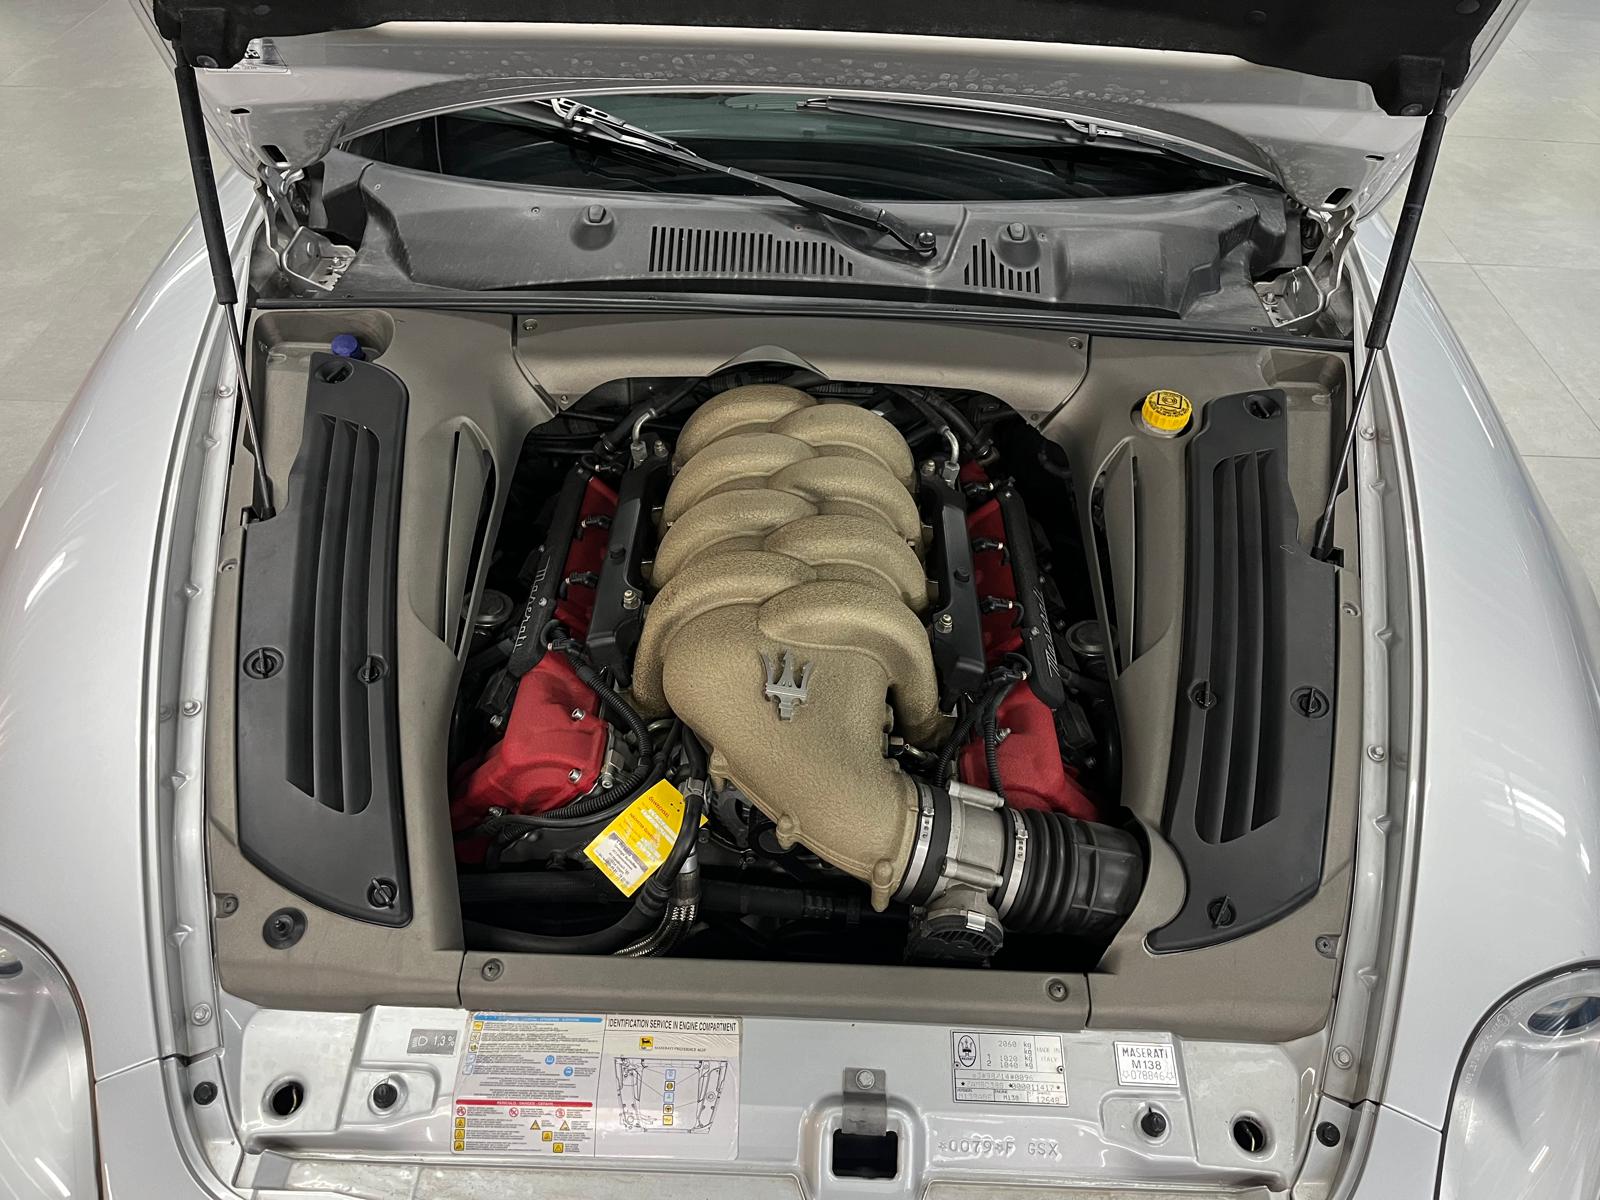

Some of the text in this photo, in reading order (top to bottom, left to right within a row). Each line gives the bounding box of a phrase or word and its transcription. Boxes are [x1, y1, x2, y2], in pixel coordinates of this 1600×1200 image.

[513, 556, 550, 653] Maserati
[608, 1018, 649, 1028] IDENTIFICATION
[650, 1020, 672, 1030] SERVICE
[673, 1021, 679, 1030] IN
[680, 1021, 698, 1031] ENGINE
[699, 1022, 737, 1032] COMPARTMENT
[999, 1040, 1032, 1049] 2060 kg
[1122, 1047, 1168, 1059] MASERATI
[1131, 1059, 1162, 1071] M138
[1027, 1142, 1059, 1156] GSX
